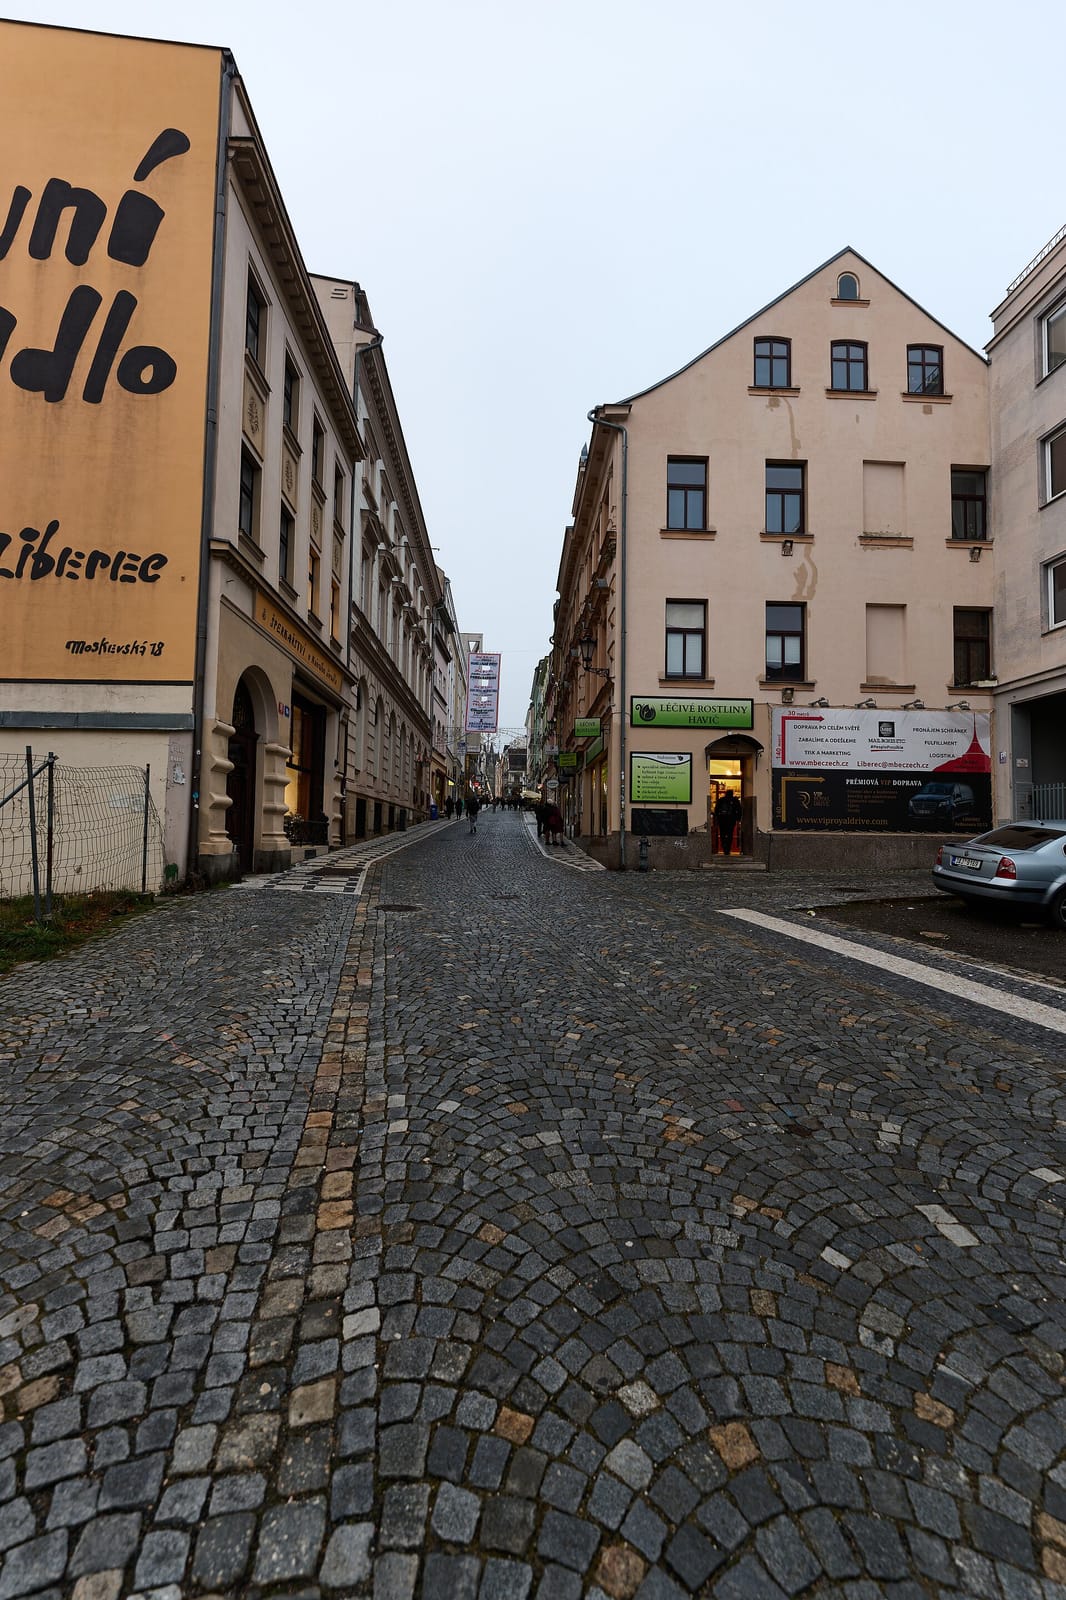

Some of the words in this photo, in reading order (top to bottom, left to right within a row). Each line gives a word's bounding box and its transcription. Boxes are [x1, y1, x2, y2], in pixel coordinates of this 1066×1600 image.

[0, 284, 177, 403] dlo
[660, 702, 695, 713] LÉČIVÉ
[698, 704, 748, 714] ROSTLINY
[857, 761, 929, 769] Liberec@mbeczech.cz
[845, 778, 879, 786] PRÉMIOVÁ
[797, 817, 888, 826] www.viproyaldrive.com
